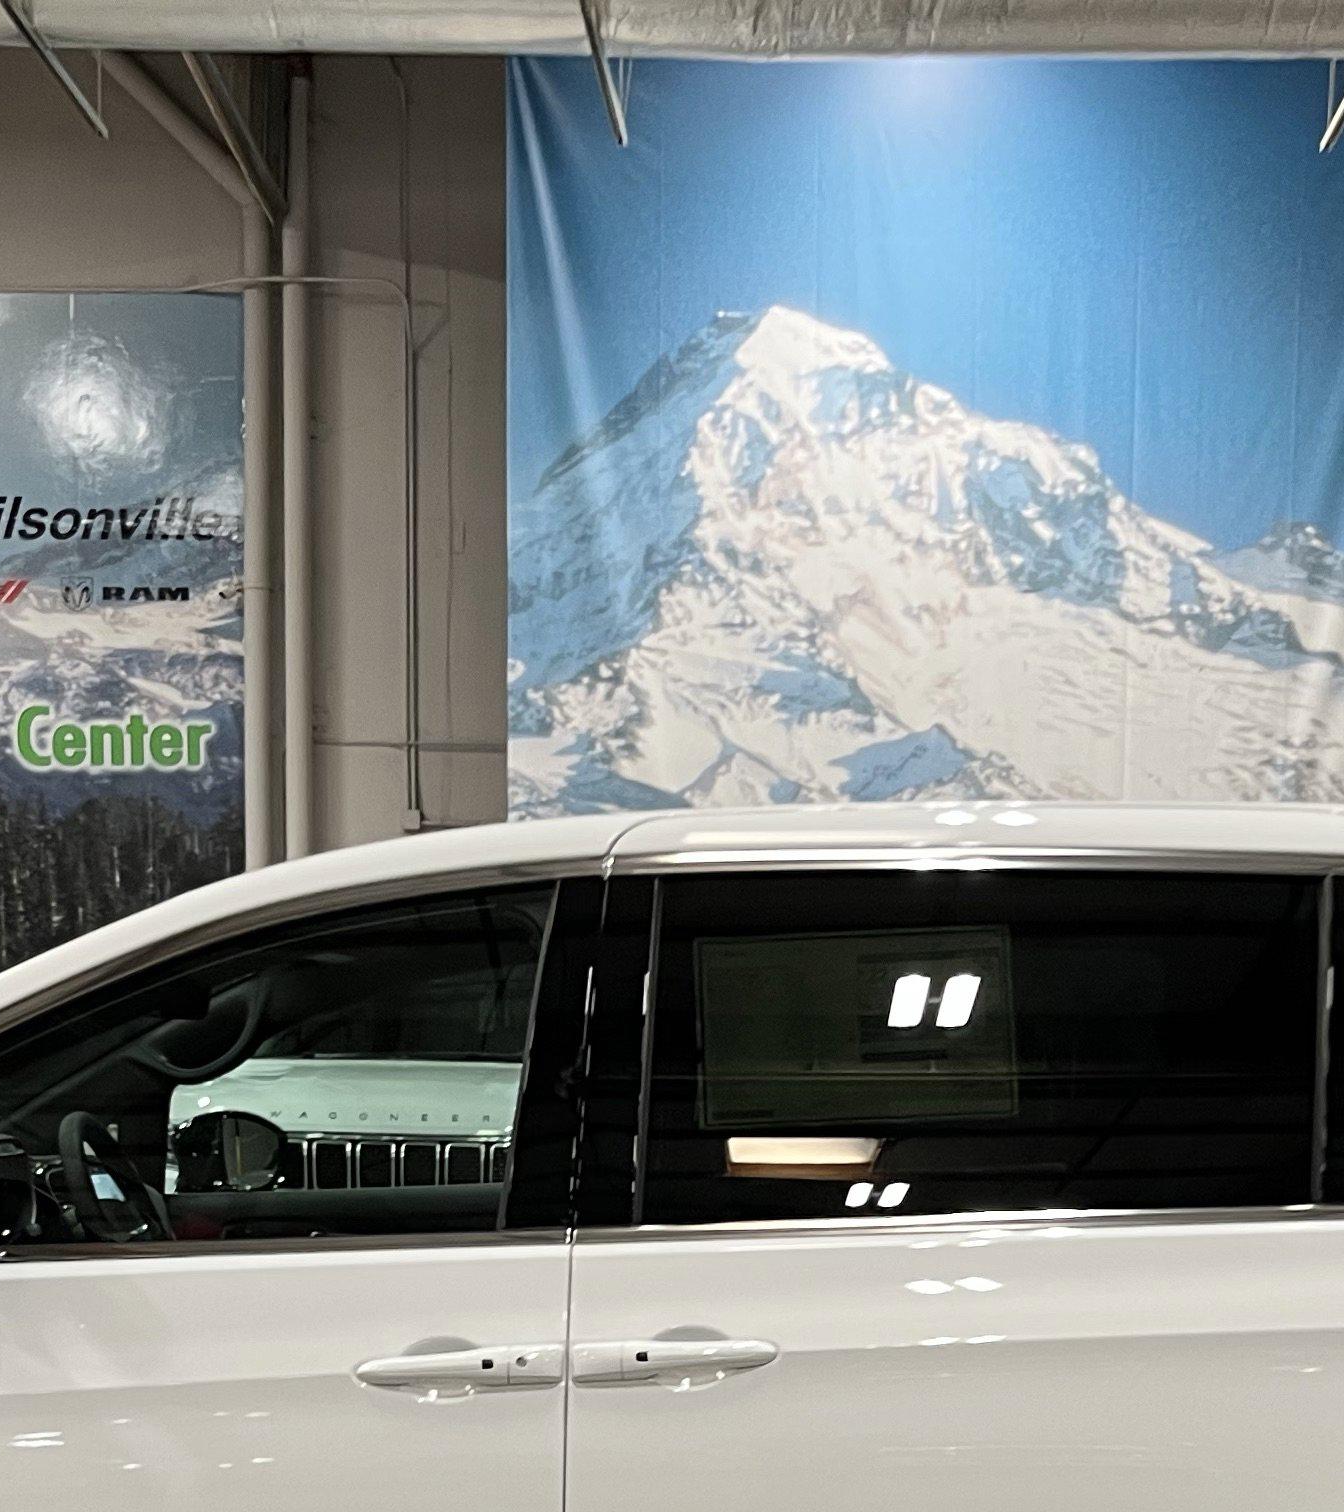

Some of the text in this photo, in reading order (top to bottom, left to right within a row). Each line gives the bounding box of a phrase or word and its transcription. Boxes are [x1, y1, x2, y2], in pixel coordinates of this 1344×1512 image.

[102, 587, 190, 601] RAM
[16, 705, 212, 766] Center
[270, 1110, 490, 1122] WAGONEER
